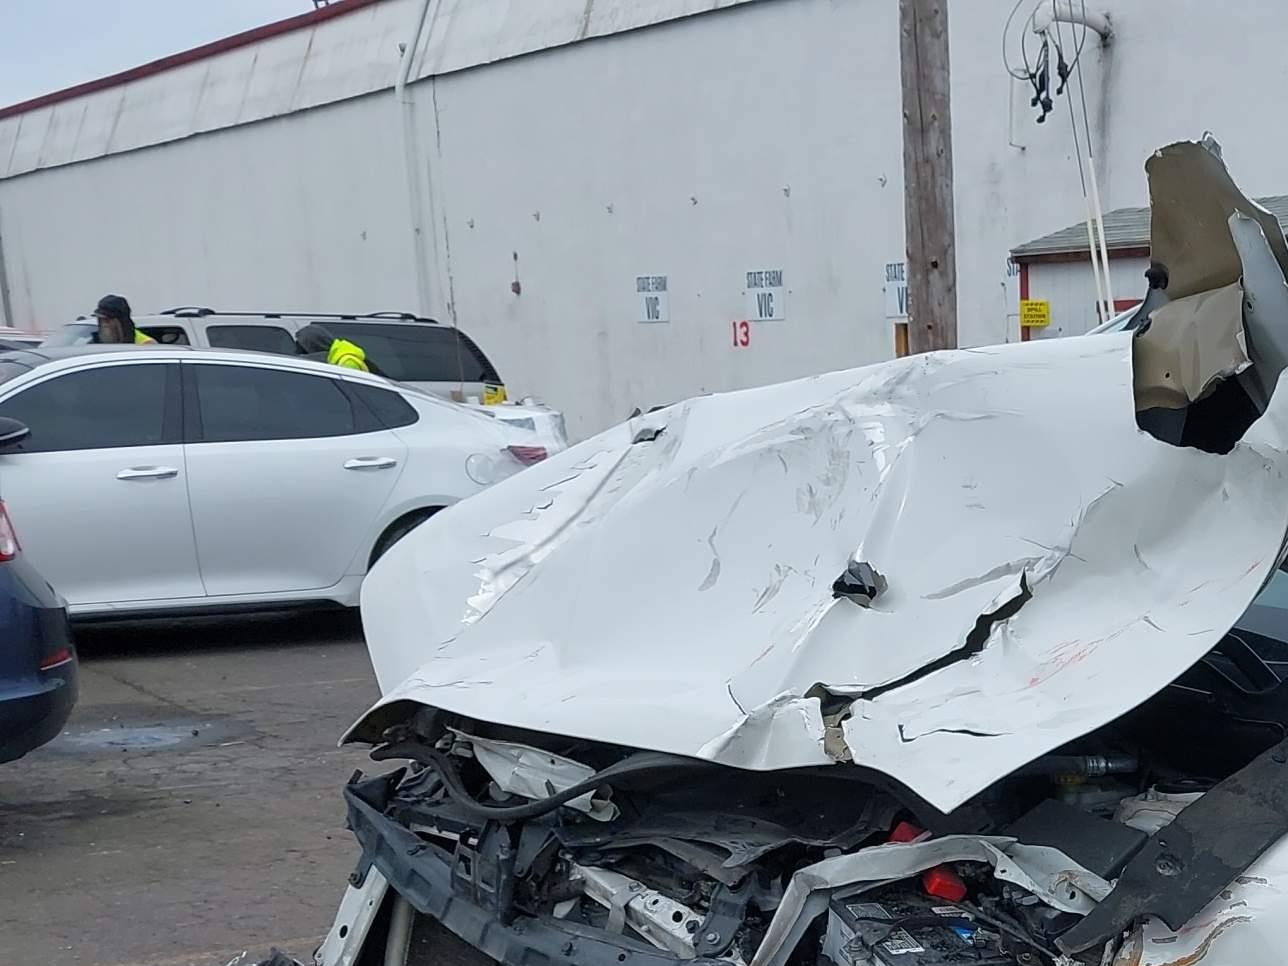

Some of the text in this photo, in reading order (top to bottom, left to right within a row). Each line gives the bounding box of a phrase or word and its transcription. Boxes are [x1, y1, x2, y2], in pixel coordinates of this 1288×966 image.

[746, 270, 783, 288] STATE FARM
[886, 263, 905, 282] STATE
[645, 296, 660, 320] VIC
[756, 293, 774, 318] VIC
[897, 287, 909, 313] VI
[732, 320, 750, 348] 13
